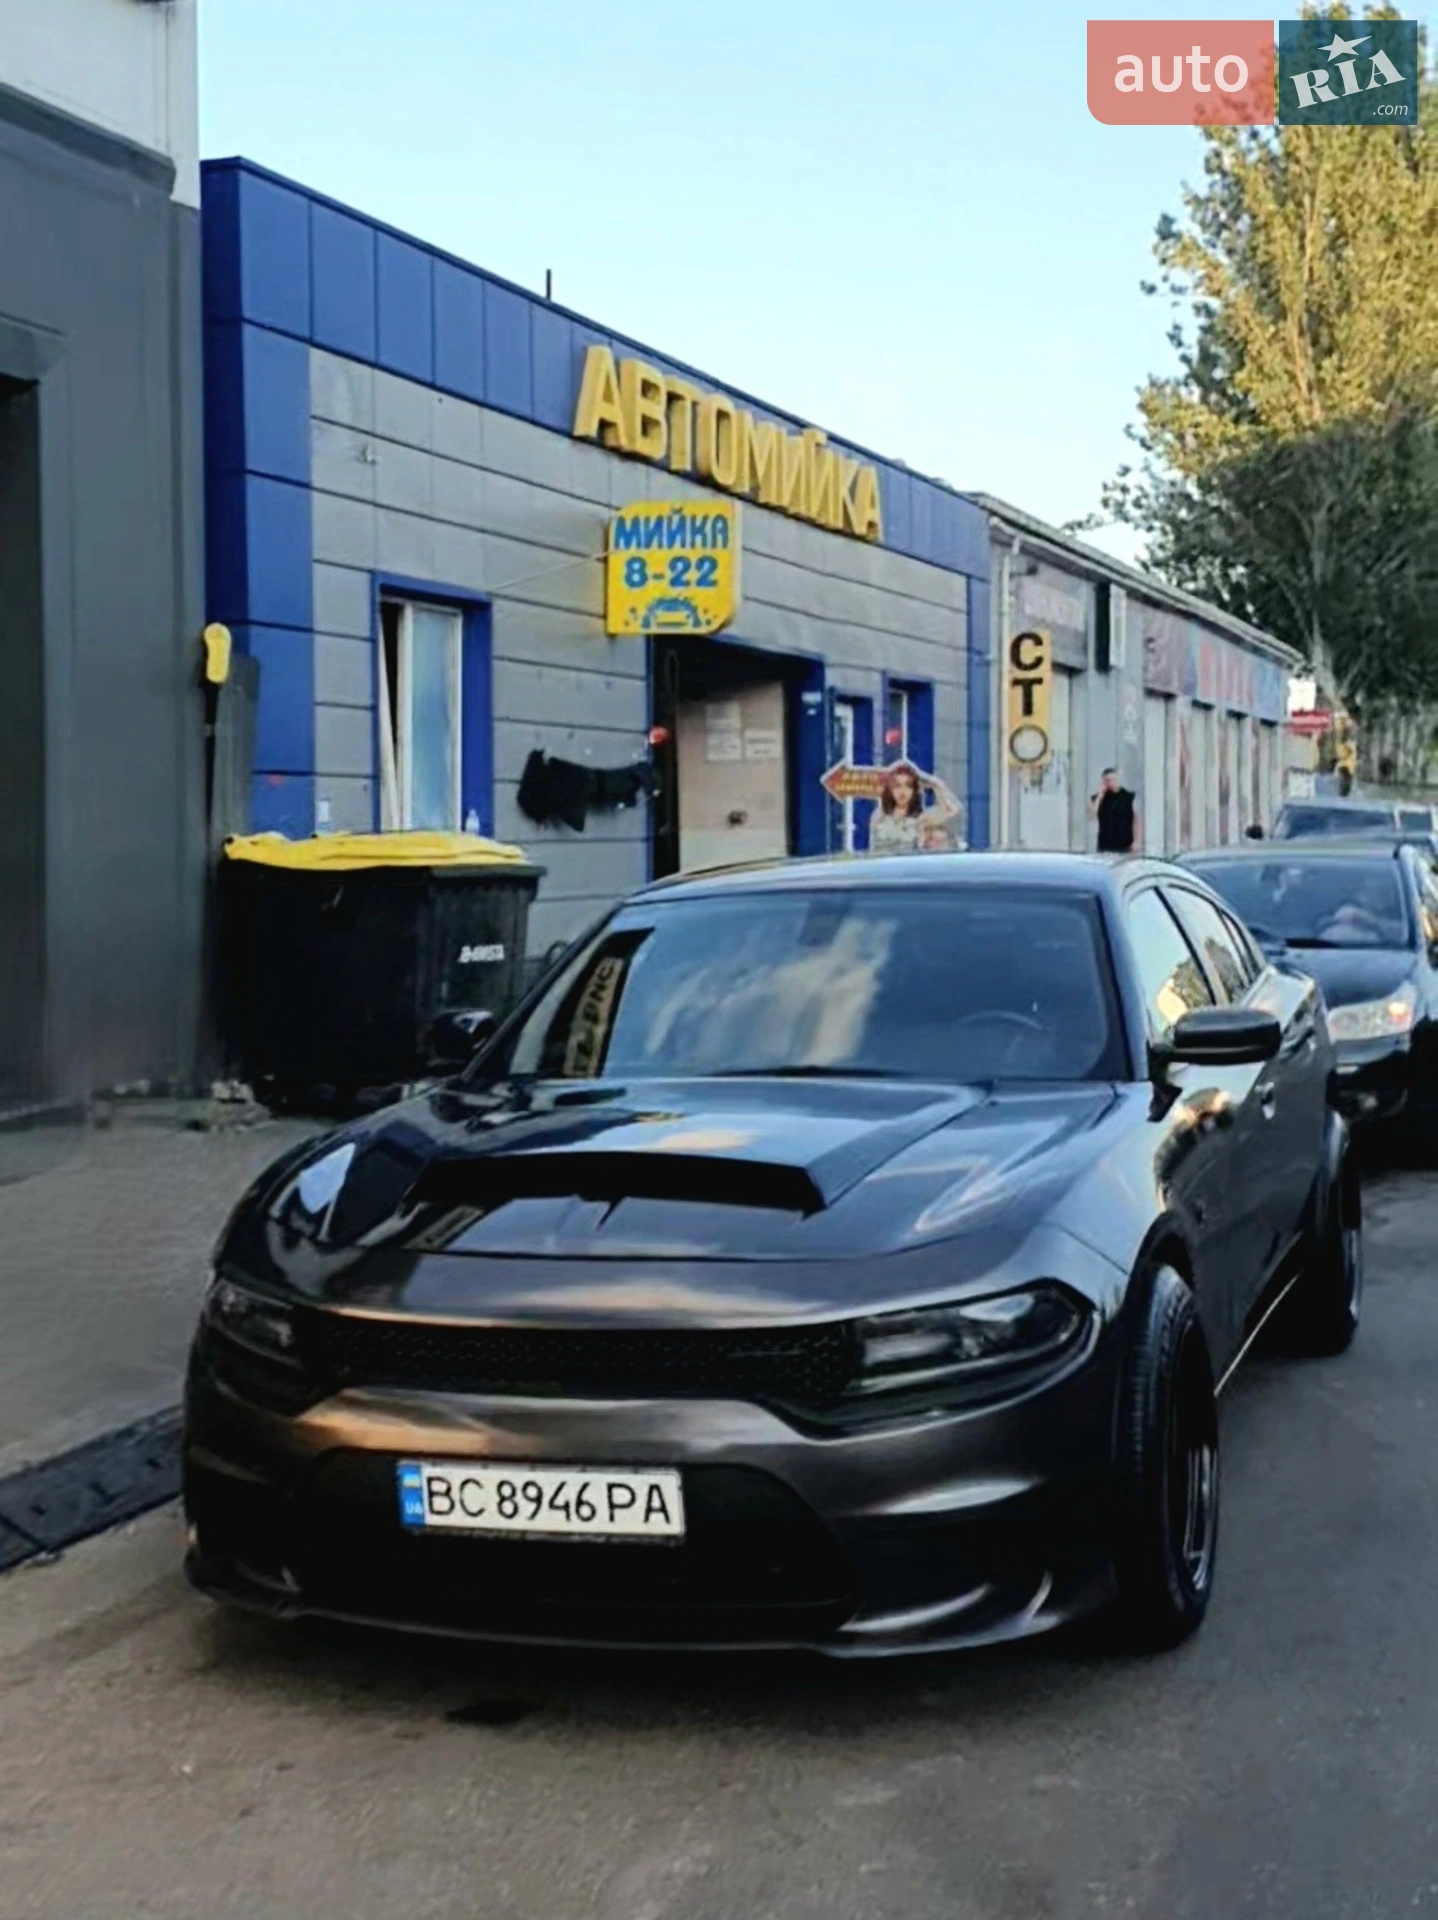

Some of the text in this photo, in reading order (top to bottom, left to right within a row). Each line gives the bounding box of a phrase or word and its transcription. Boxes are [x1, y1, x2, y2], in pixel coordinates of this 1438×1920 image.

[573, 345, 884, 542] АВТОМИЙКА
[613, 507, 730, 551] МИЙКА
[623, 555, 719, 589] 8-22
[1009, 631, 1048, 763] СТО
